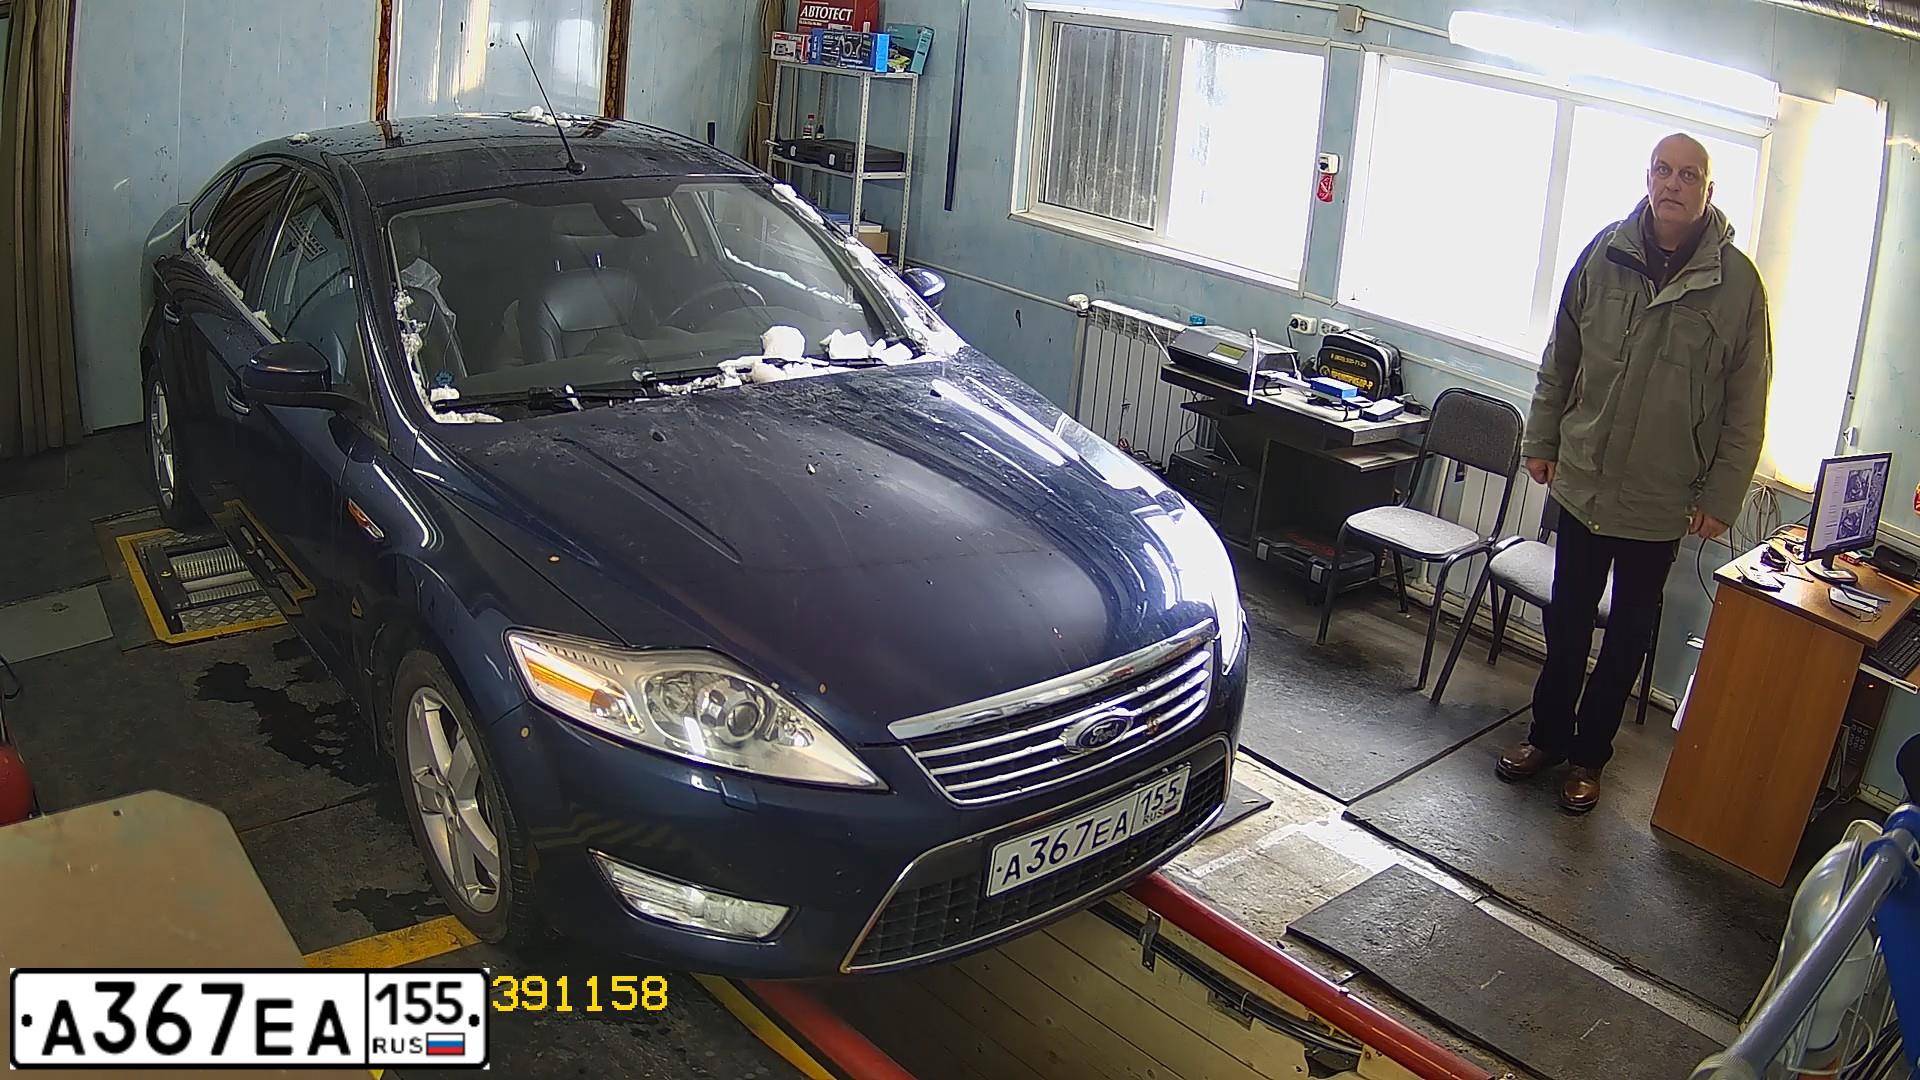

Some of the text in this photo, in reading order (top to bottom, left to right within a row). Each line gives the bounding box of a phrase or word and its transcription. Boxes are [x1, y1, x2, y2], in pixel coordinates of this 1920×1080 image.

[800, 5, 853, 21] АВТОТЕСТ
[1089, 721, 1119, 745] Ford
[1142, 807, 1164, 825] RUS
[1002, 776, 1181, 885] А367ЕА 155
